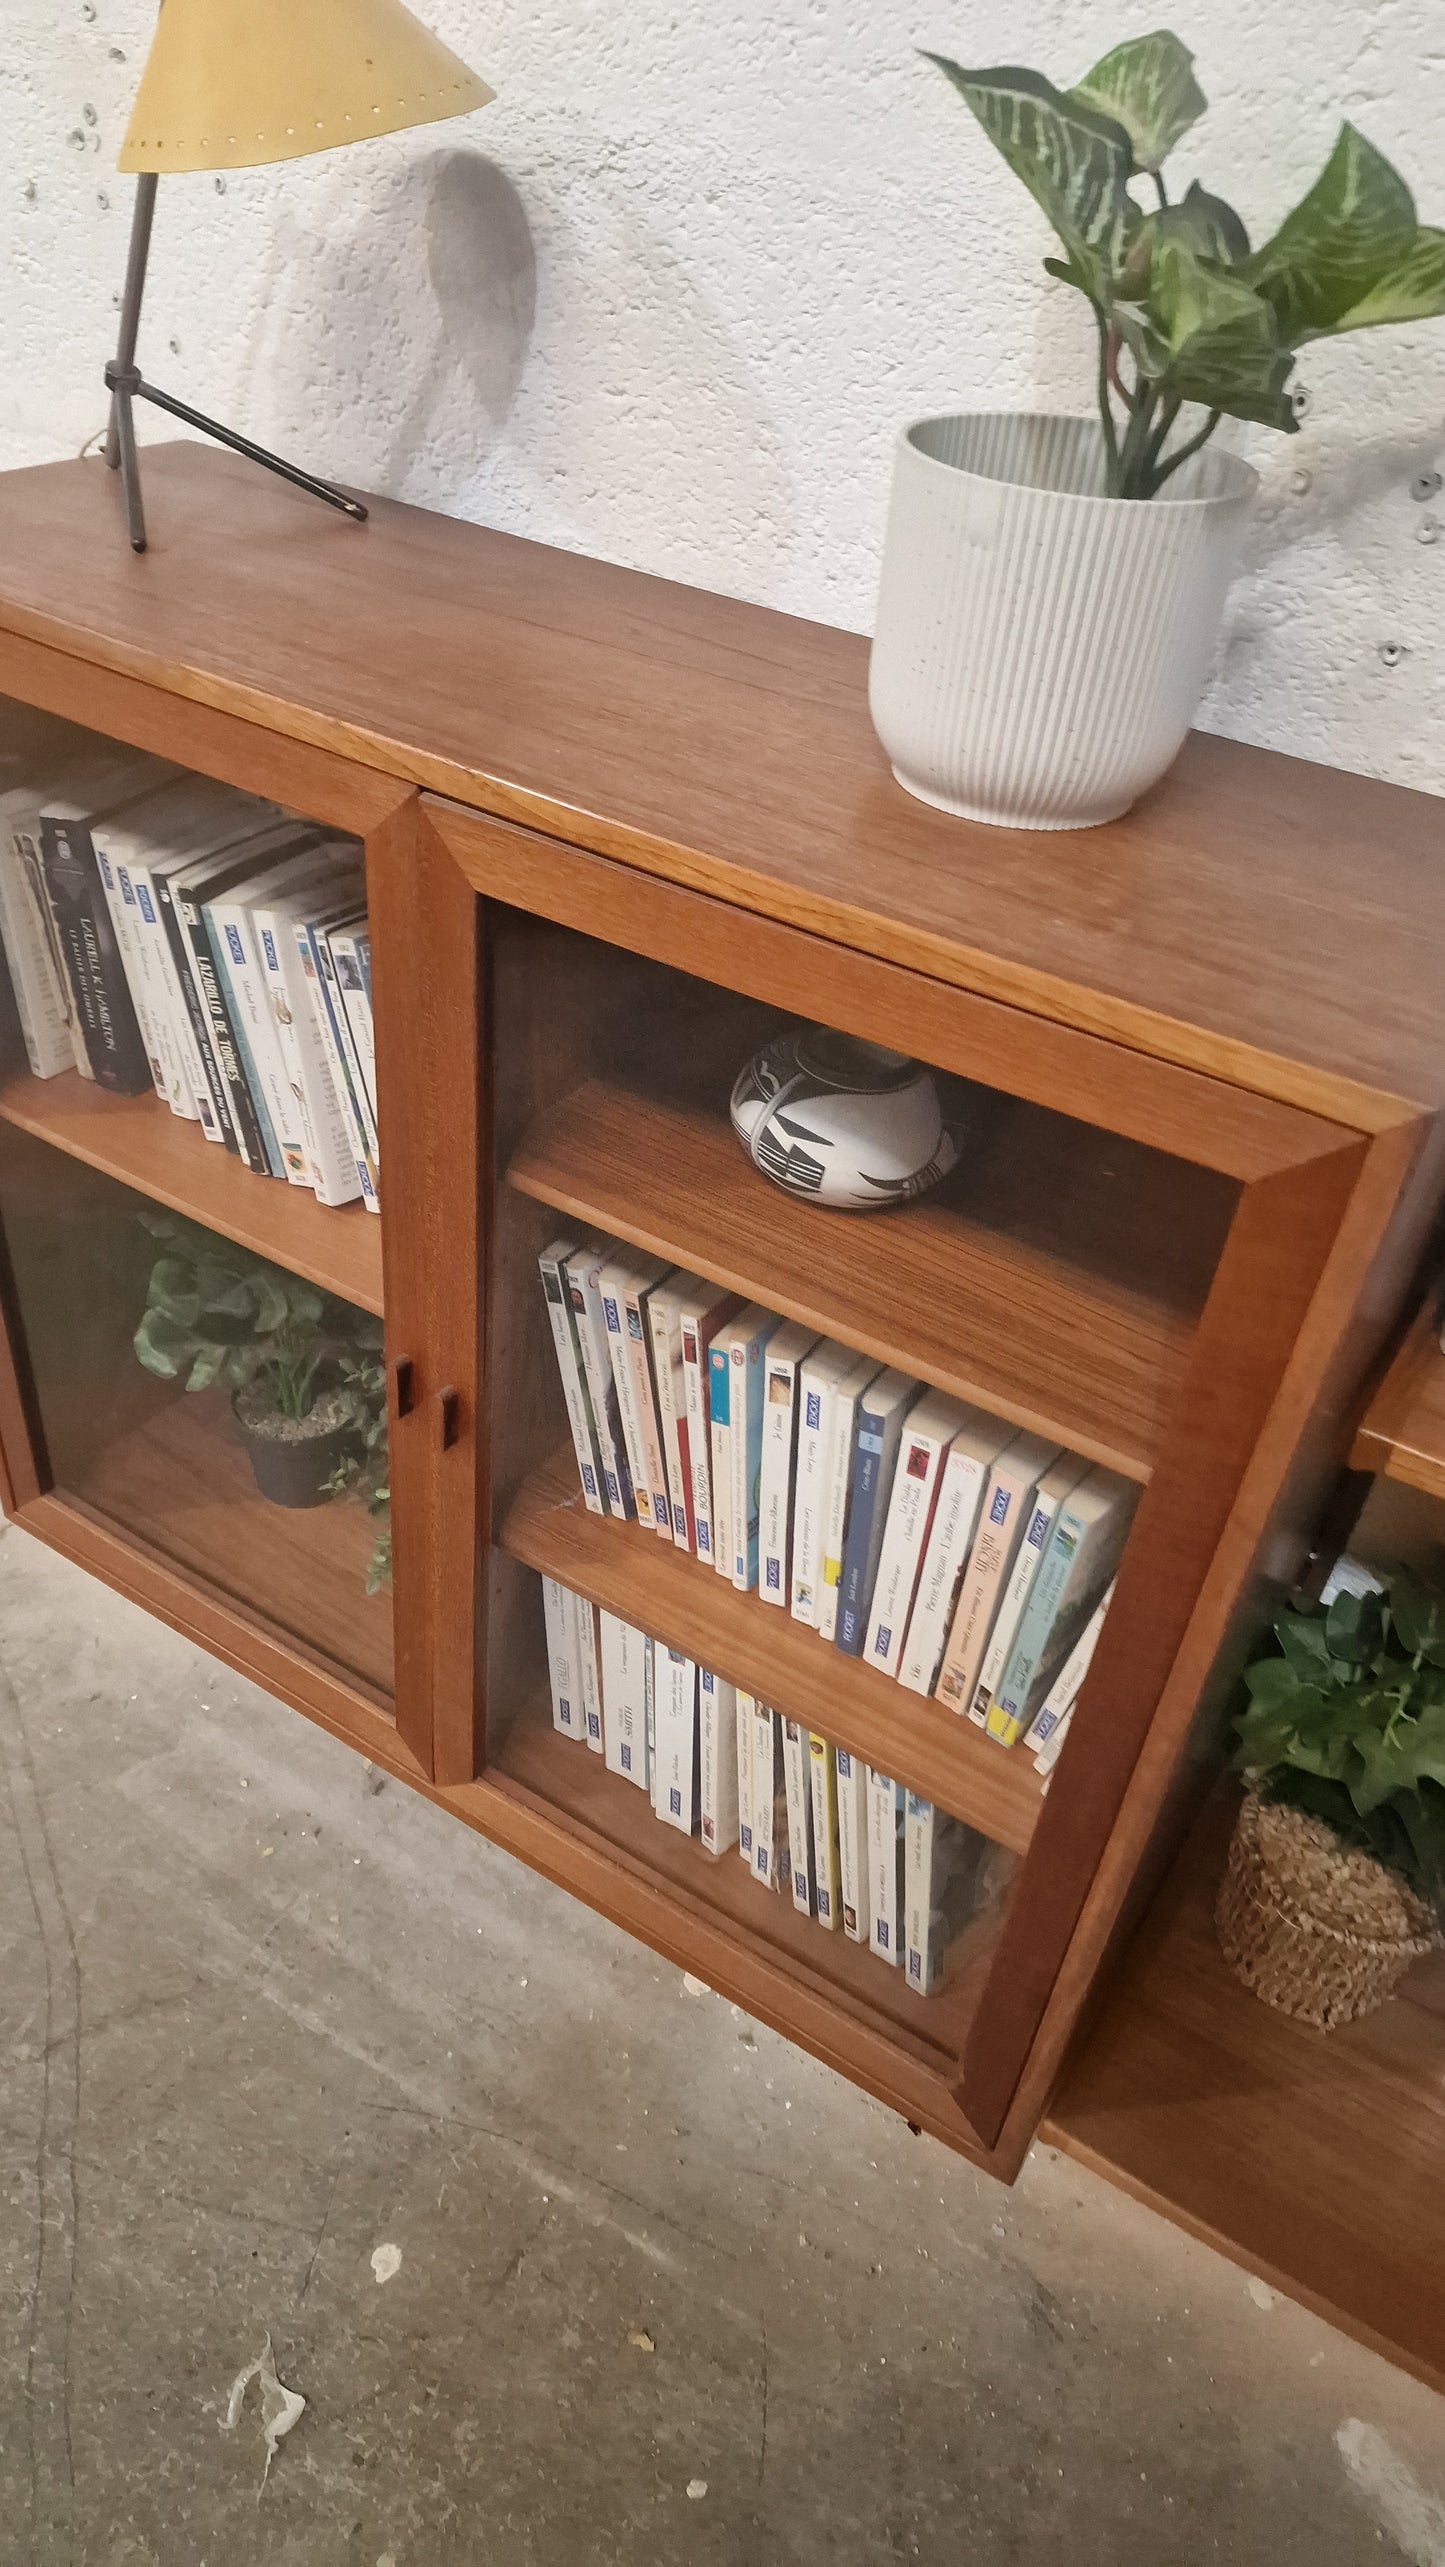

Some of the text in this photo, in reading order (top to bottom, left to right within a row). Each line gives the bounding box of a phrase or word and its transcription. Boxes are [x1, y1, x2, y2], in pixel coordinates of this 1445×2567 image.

[117, 867, 135, 904] POCKET
[135, 886, 155, 923] POCKET
[224, 925, 245, 964] POCKET
[261, 930, 279, 970] POCKET
[80, 918, 101, 971] LAURELL
[94, 989, 116, 1050] HAMILTON
[195, 957, 224, 1014] LAZARILLO
[212, 1020, 228, 1034] DE
[201, 1042, 213, 1059] AUX
[217, 1040, 241, 1081] TORMES
[205, 1060, 222, 1095] SOURCES
[216, 1098, 227, 1112] DU
[220, 1114, 231, 1129] VENT
[604, 1298, 619, 1332] POCKET
[807, 1391, 819, 1430] POCKET
[806, 1439, 815, 1474] Marc Levy
[581, 1462, 596, 1496] POCKET
[605, 1469, 619, 1502] POCKET
[695, 1462, 708, 1510] BOURDIN
[653, 1492, 667, 1524] POCKET
[940, 1487, 963, 1550] L'aube insolite
[991, 1487, 1009, 1525] POCKET
[696, 1517, 709, 1551] POCKET
[1028, 1510, 1048, 1548] POCKET
[767, 1557, 778, 1588] POCKET
[926, 1553, 948, 1612] Pierre Magnan
[842, 1609, 854, 1642] POCKET
[875, 1624, 890, 1656] POCKET
[624, 1704, 632, 1737] SMITH
